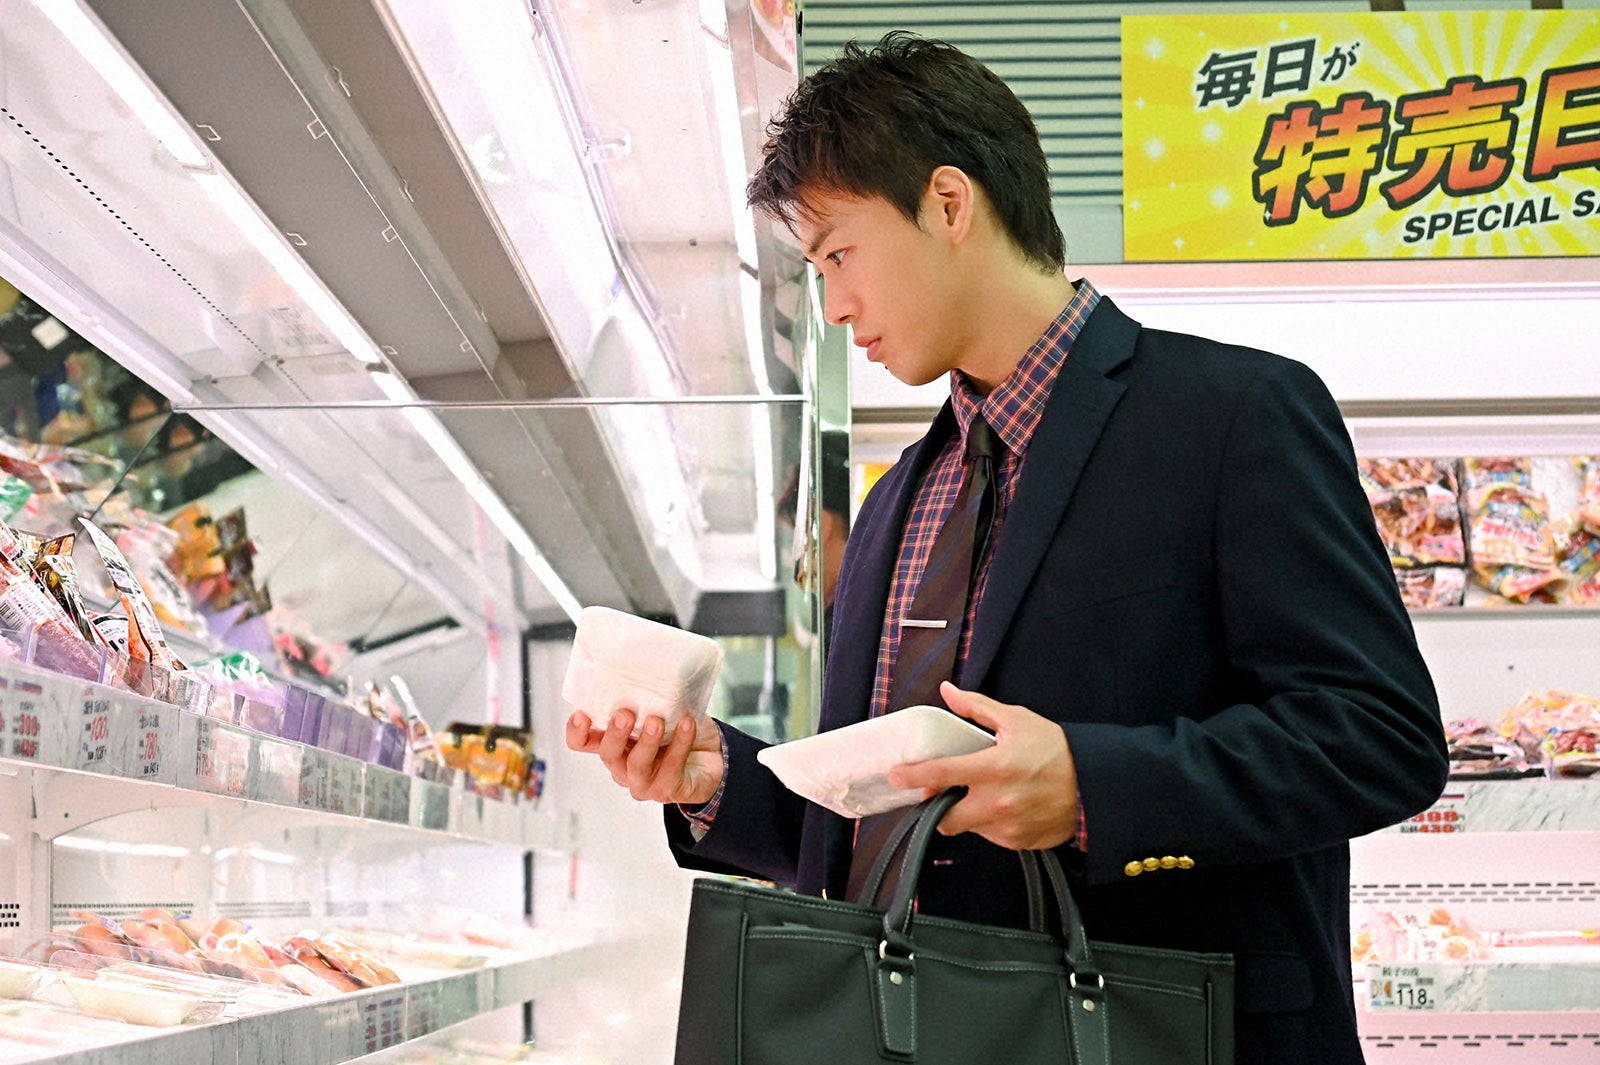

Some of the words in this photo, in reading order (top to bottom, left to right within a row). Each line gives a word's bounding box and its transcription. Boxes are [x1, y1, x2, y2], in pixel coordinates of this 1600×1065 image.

[1196, 39, 1360, 107] 毎日が
[1252, 62, 1600, 227] 特売日
[1403, 196, 1560, 243] SPECIAL
[1572, 190, 1600, 217] S
[1396, 988, 1427, 1005] 118
